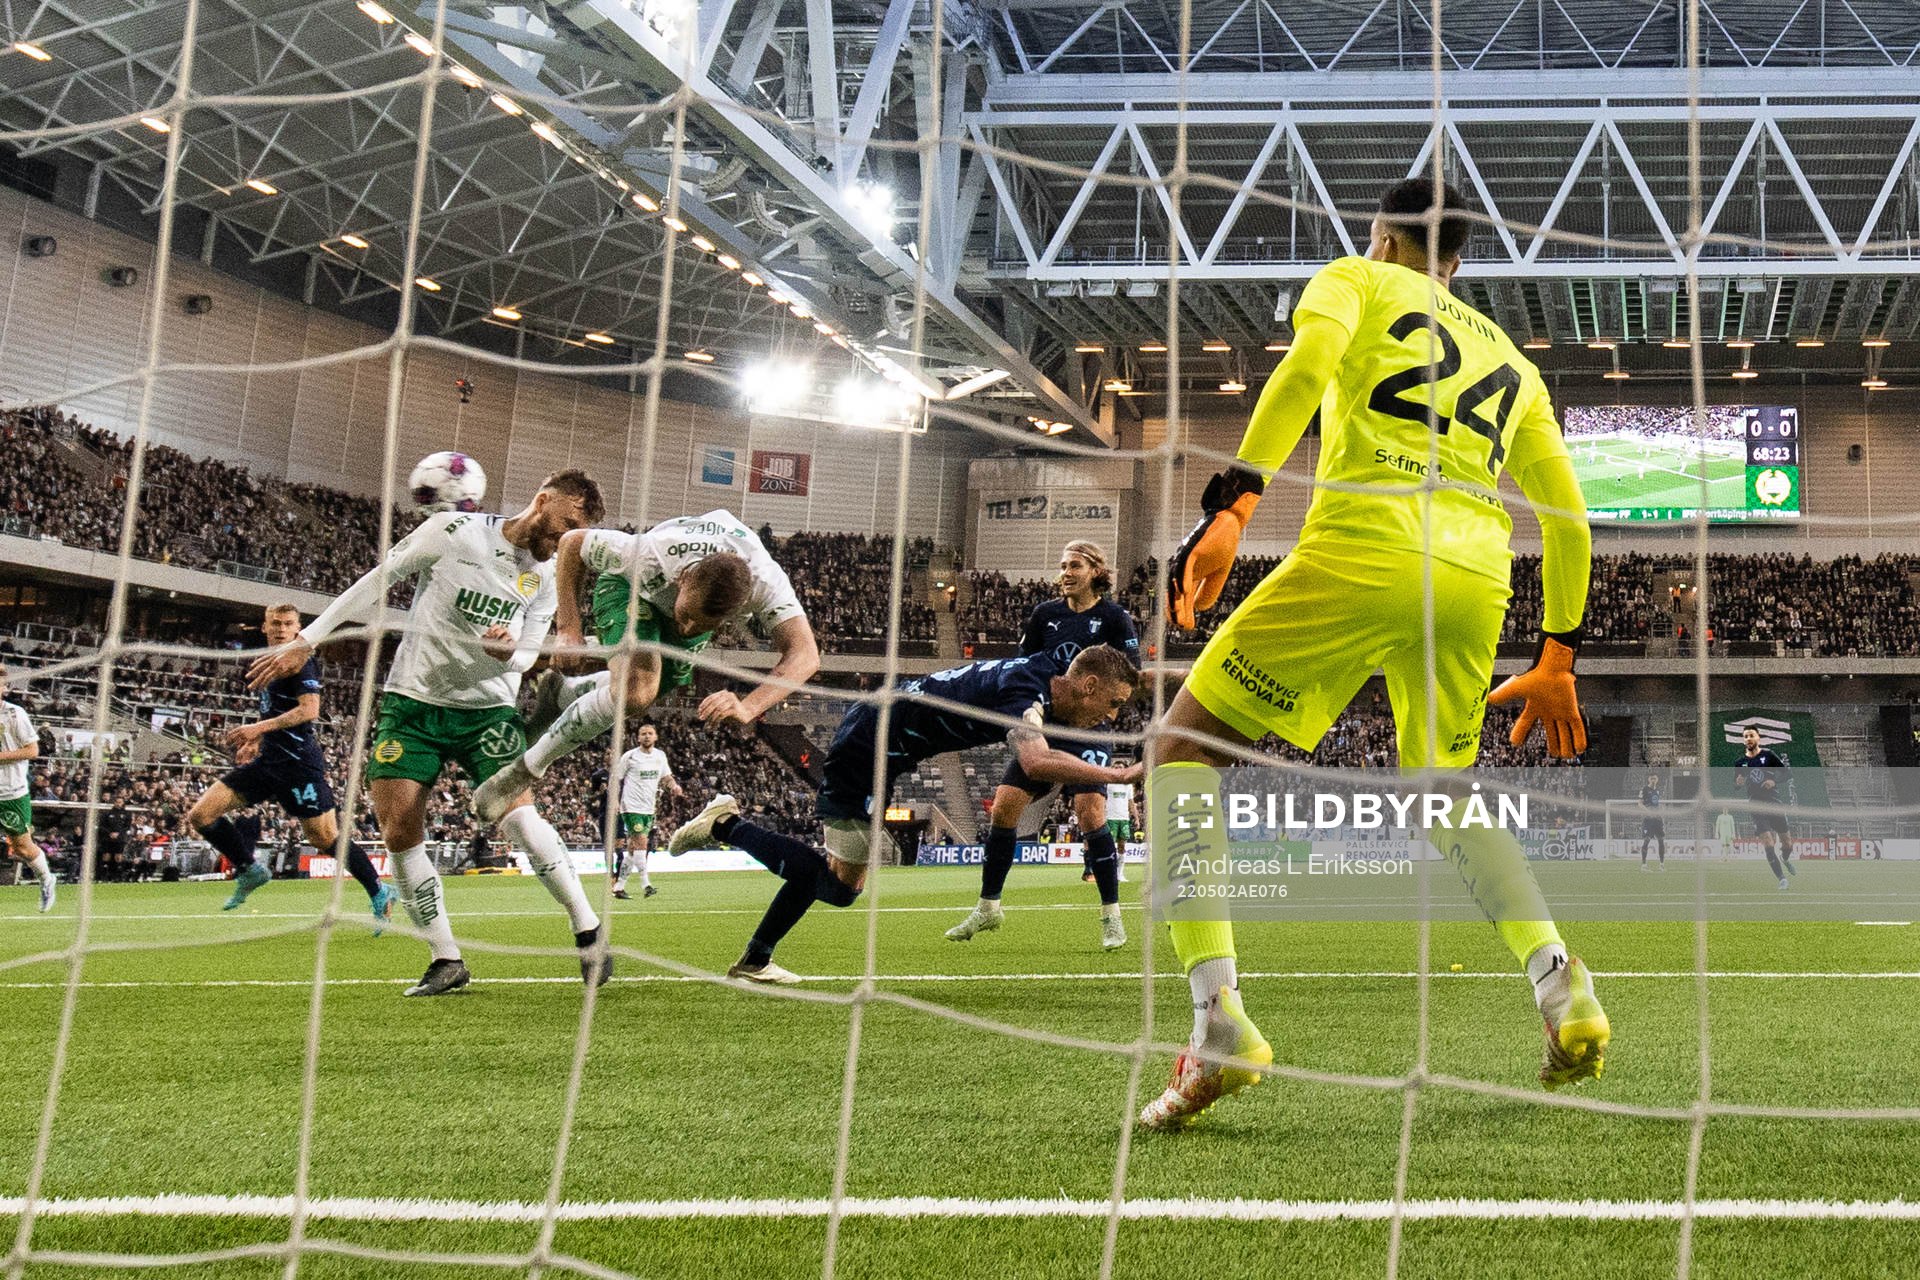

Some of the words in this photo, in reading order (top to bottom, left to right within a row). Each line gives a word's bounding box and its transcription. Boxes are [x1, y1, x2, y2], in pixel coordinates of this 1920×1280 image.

[1434, 294, 1497, 343] DOVIN
[1367, 311, 1522, 477] 24
[1752, 446, 1791, 462] 68:23
[765, 457, 794, 478] JOB
[760, 478, 797, 492] ZONE
[985, 495, 1048, 520] TELE2
[1050, 502, 1112, 520] Arena
[455, 587, 522, 622] HUSKI
[1221, 657, 1274, 705] RENOVA
[1273, 697, 1296, 713] AB
[1230, 647, 1301, 700] PALLSERVICE
[1081, 749, 1110, 768] 37
[291, 782, 318, 806] 14
[935, 846, 960, 864] THE
[1021, 846, 1048, 864] BAR
[1345, 840, 1409, 849] PALLSERVICE
[1345, 850, 1392, 860] RENOVA
[1394, 850, 1410, 860] AB
[413, 875, 440, 927] Clinton
